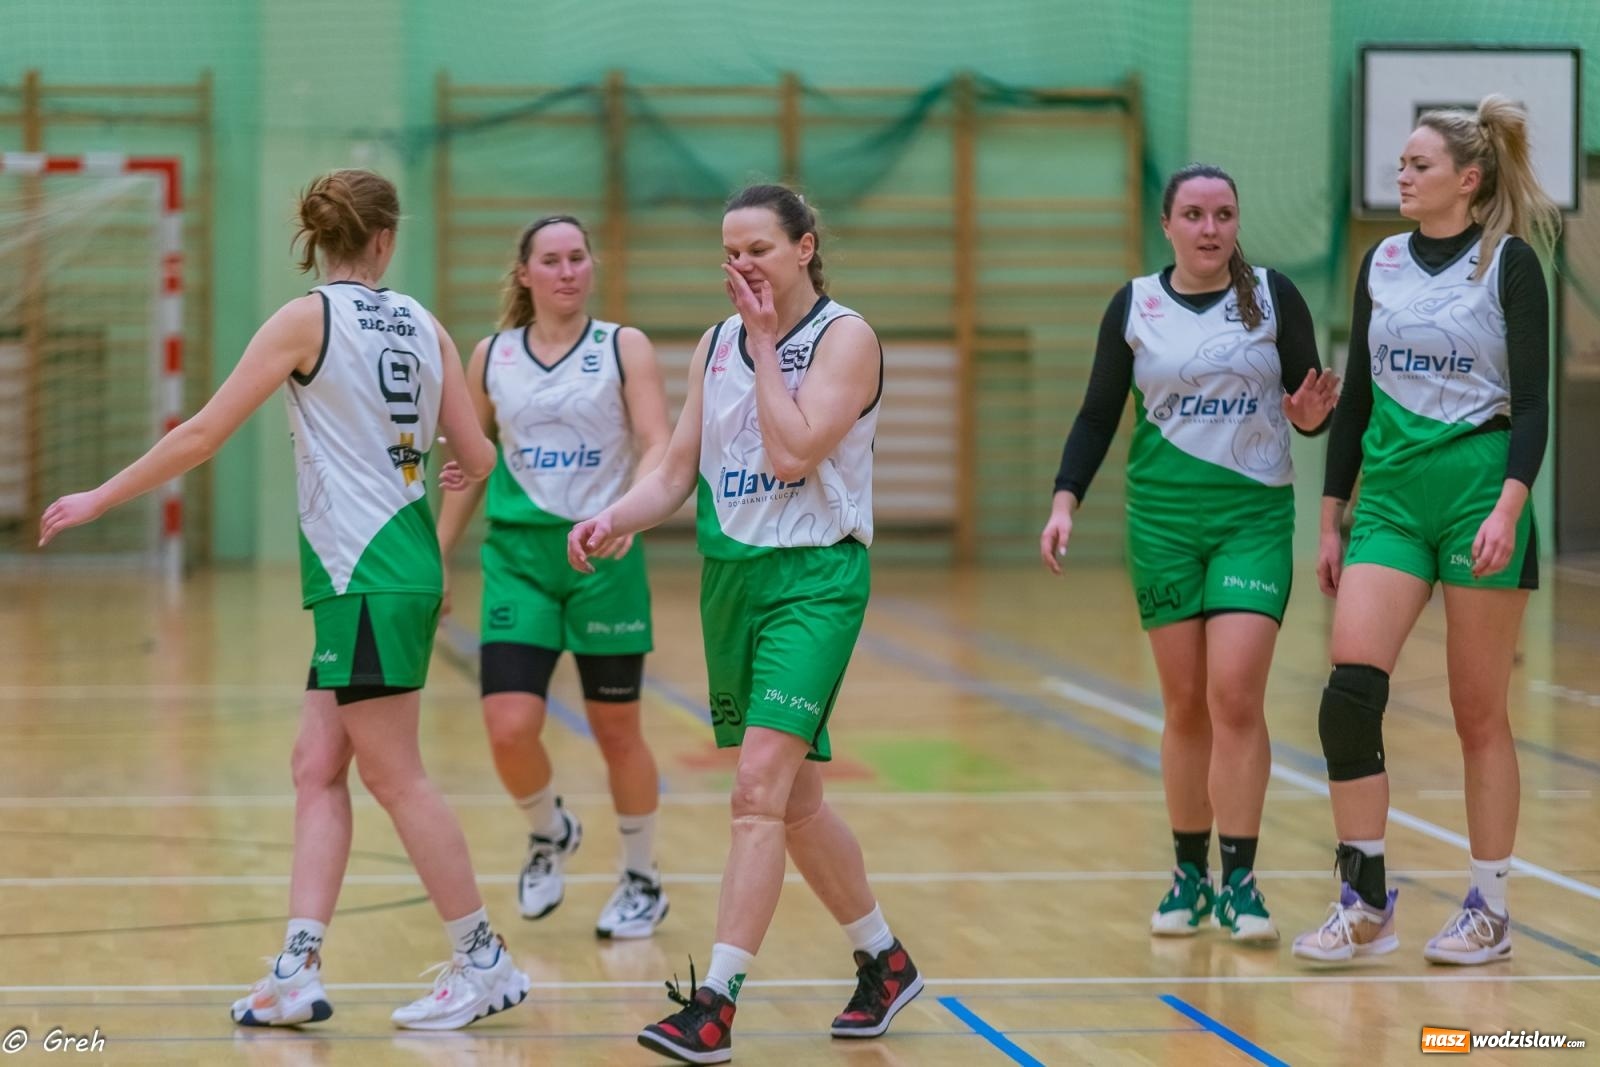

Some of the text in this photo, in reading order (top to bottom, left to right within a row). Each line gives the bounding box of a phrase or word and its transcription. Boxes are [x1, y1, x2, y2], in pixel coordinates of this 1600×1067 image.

[1389, 348, 1475, 374] Clavis
[1179, 392, 1258, 417] Clavis
[519, 444, 603, 469] Clavis
